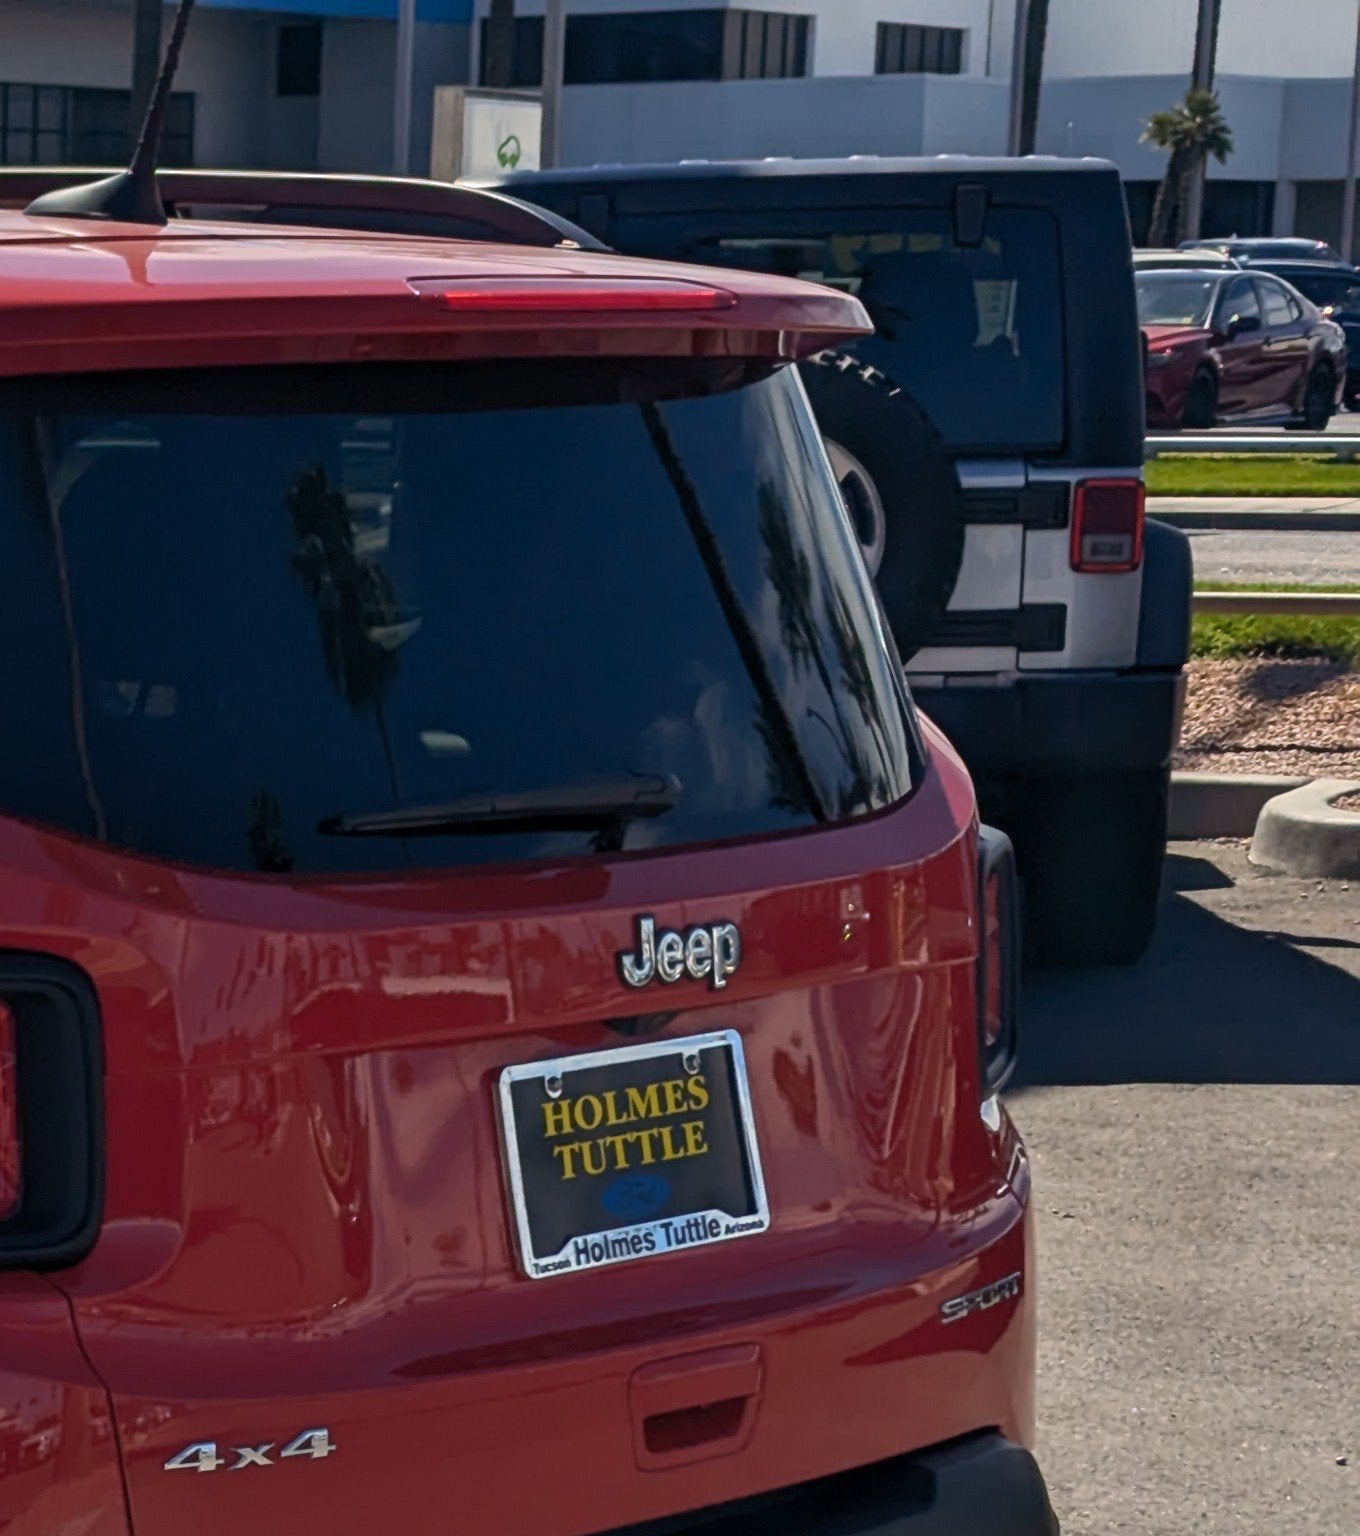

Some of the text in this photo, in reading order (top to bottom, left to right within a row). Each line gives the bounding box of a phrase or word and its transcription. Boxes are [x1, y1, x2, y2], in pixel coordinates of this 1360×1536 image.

[620, 914, 741, 989] Jeep
[540, 1074, 710, 1138] HOLMES
[552, 1120, 709, 1181] TUTTLE
[532, 1214, 766, 1275] Tucson Holmes Tuttle Arizona
[163, 1427, 338, 1473] 4x4
